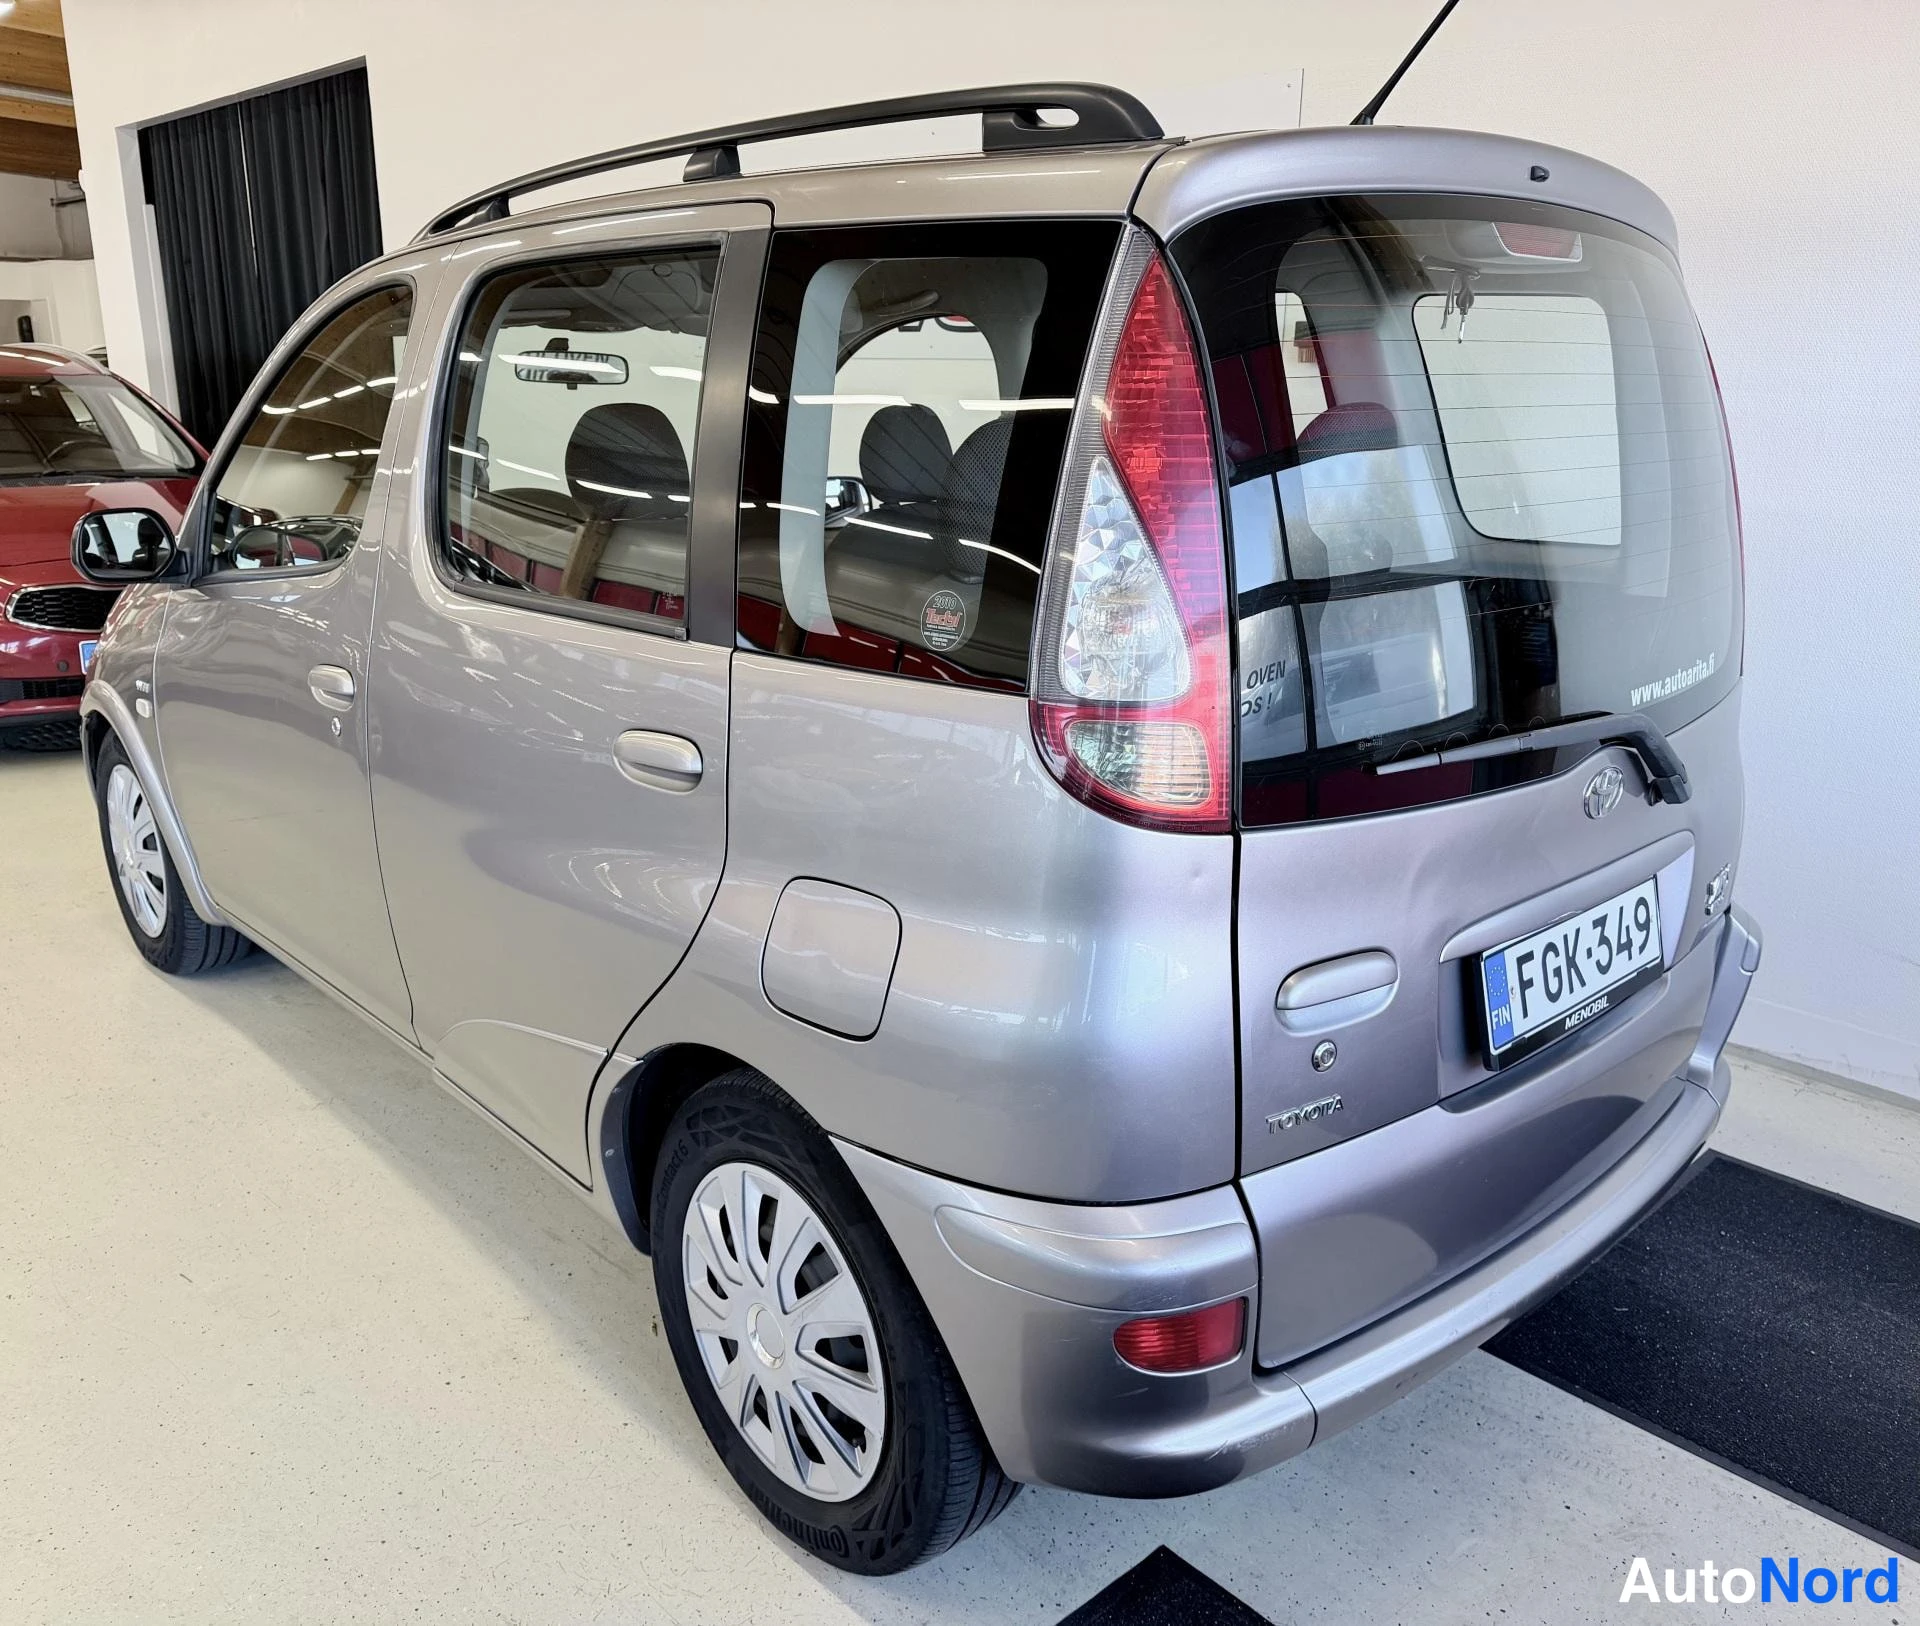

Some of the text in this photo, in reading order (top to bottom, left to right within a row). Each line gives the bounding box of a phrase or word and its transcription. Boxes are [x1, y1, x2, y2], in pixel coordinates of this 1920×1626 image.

[1246, 660, 1286, 690] OVEN
[1631, 652, 1715, 706] www.autoarita.fi
[1491, 1004, 1512, 1030] FIN
[1564, 995, 1610, 1030] MENOBIL
[1265, 1094, 1344, 1134] TOYOTA
